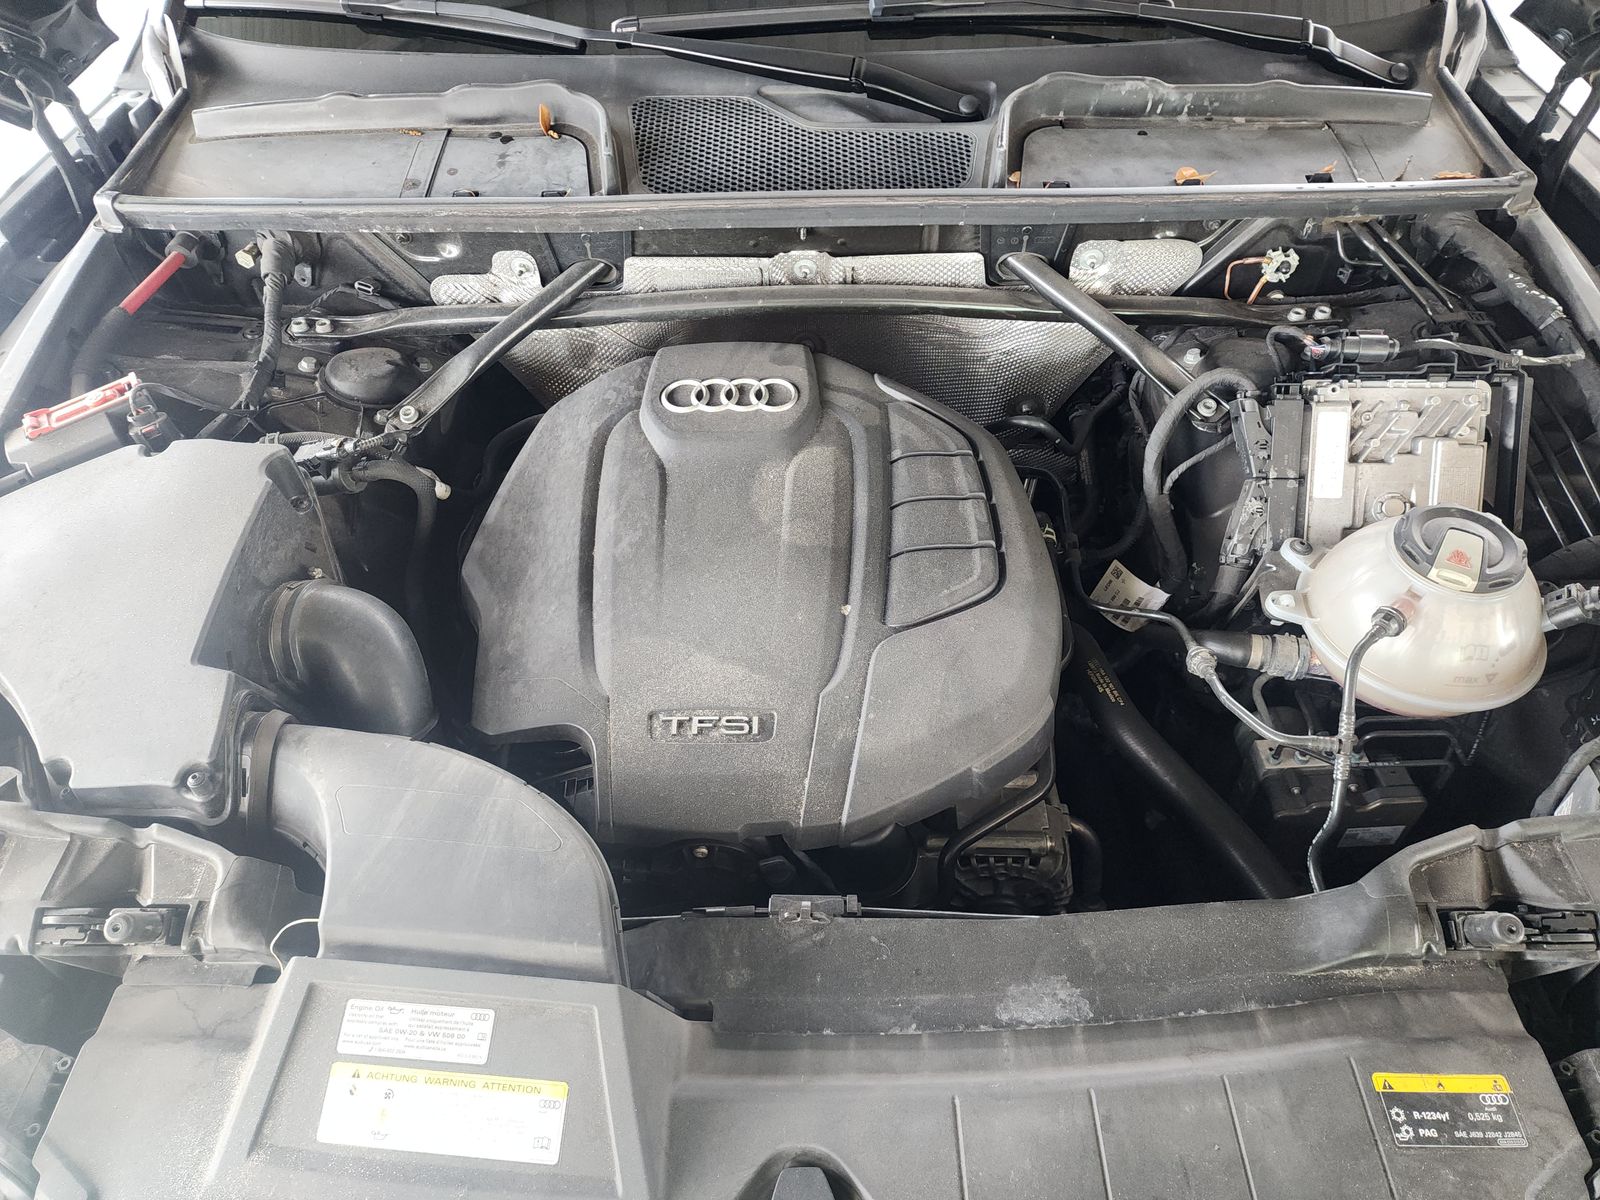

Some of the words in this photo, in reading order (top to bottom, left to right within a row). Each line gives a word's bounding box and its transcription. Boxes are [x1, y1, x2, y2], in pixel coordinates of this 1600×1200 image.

[659, 715, 759, 735] TFSI
[350, 1003, 373, 1012] Engine
[366, 1071, 418, 1084] ACHTUNG
[424, 1076, 476, 1089] WARNING
[482, 1080, 542, 1095] ATTENTION
[1413, 1111, 1450, 1121] R-1234yf
[1467, 1112, 1491, 1122] 0,525
[1491, 1112, 1504, 1123] kg
[1418, 1128, 1438, 1138] PAG
